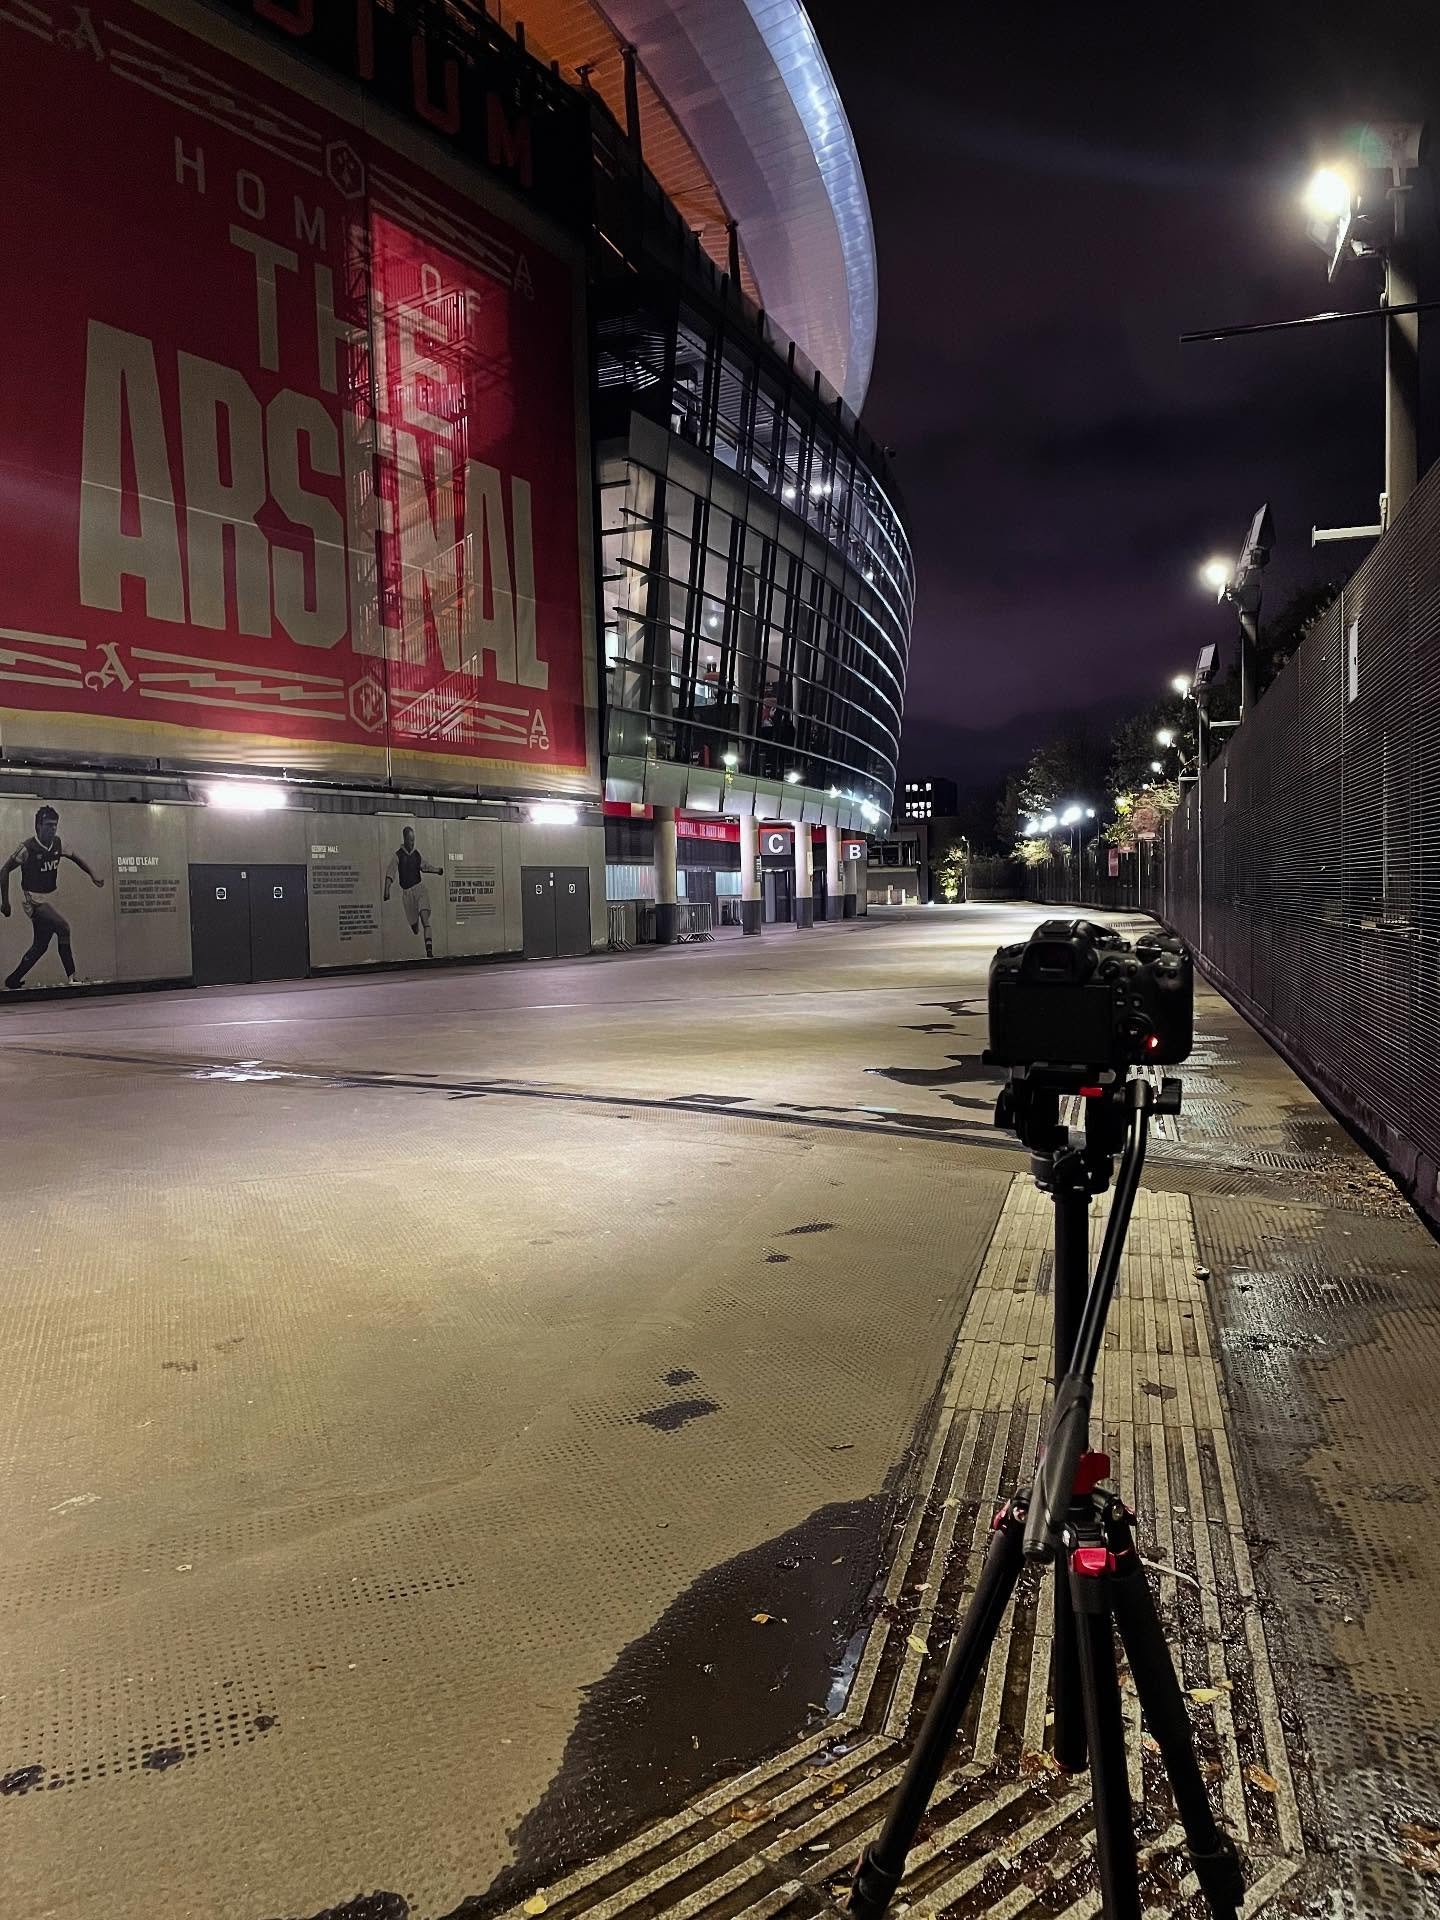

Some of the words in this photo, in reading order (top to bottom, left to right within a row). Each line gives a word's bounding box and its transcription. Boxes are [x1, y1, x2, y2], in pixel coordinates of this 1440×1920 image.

[420, 263, 482, 327] OF
[229, 223, 456, 441] THE
[79, 318, 549, 690] ARSENAL
[768, 833, 785, 854] C
[850, 845, 861, 860] B
[40, 860, 58, 872] JVC
[117, 856, 135, 866] DAVID
[136, 856, 159, 866] O'LEARY
